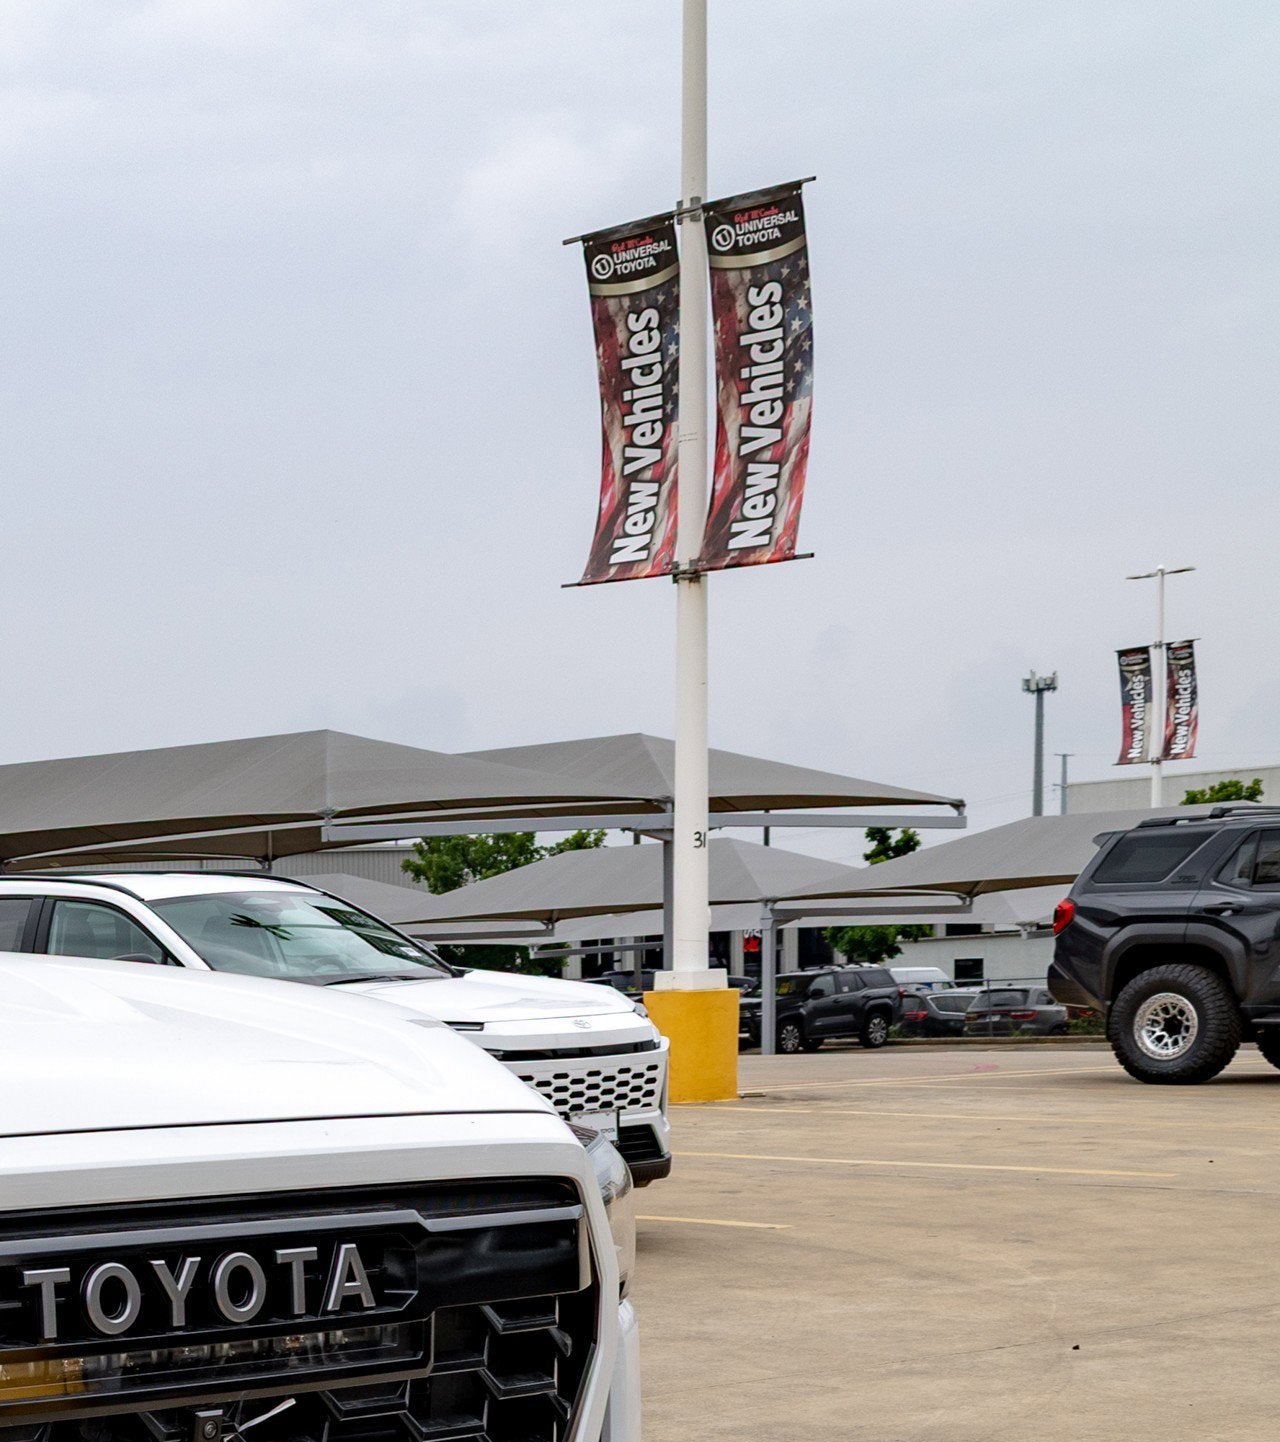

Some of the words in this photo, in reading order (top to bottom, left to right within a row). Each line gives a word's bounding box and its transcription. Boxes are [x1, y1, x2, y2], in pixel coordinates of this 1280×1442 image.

[735, 210, 799, 235] UNIVERSAL
[736, 227, 782, 247] TOYOTA
[613, 240, 672, 264] UNIVERSAL
[614, 256, 657, 275] TOYOTA
[621, 307, 663, 476] Vehicles
[739, 280, 783, 457] Vehicles
[608, 482, 660, 565] New
[728, 463, 780, 550] New
[1130, 674, 1145, 727] Vehicles
[1175, 669, 1191, 725] Vehicles
[1127, 728, 1145, 758] New
[1170, 725, 1189, 754] New
[23, 1243, 376, 1340] TOYOTA
